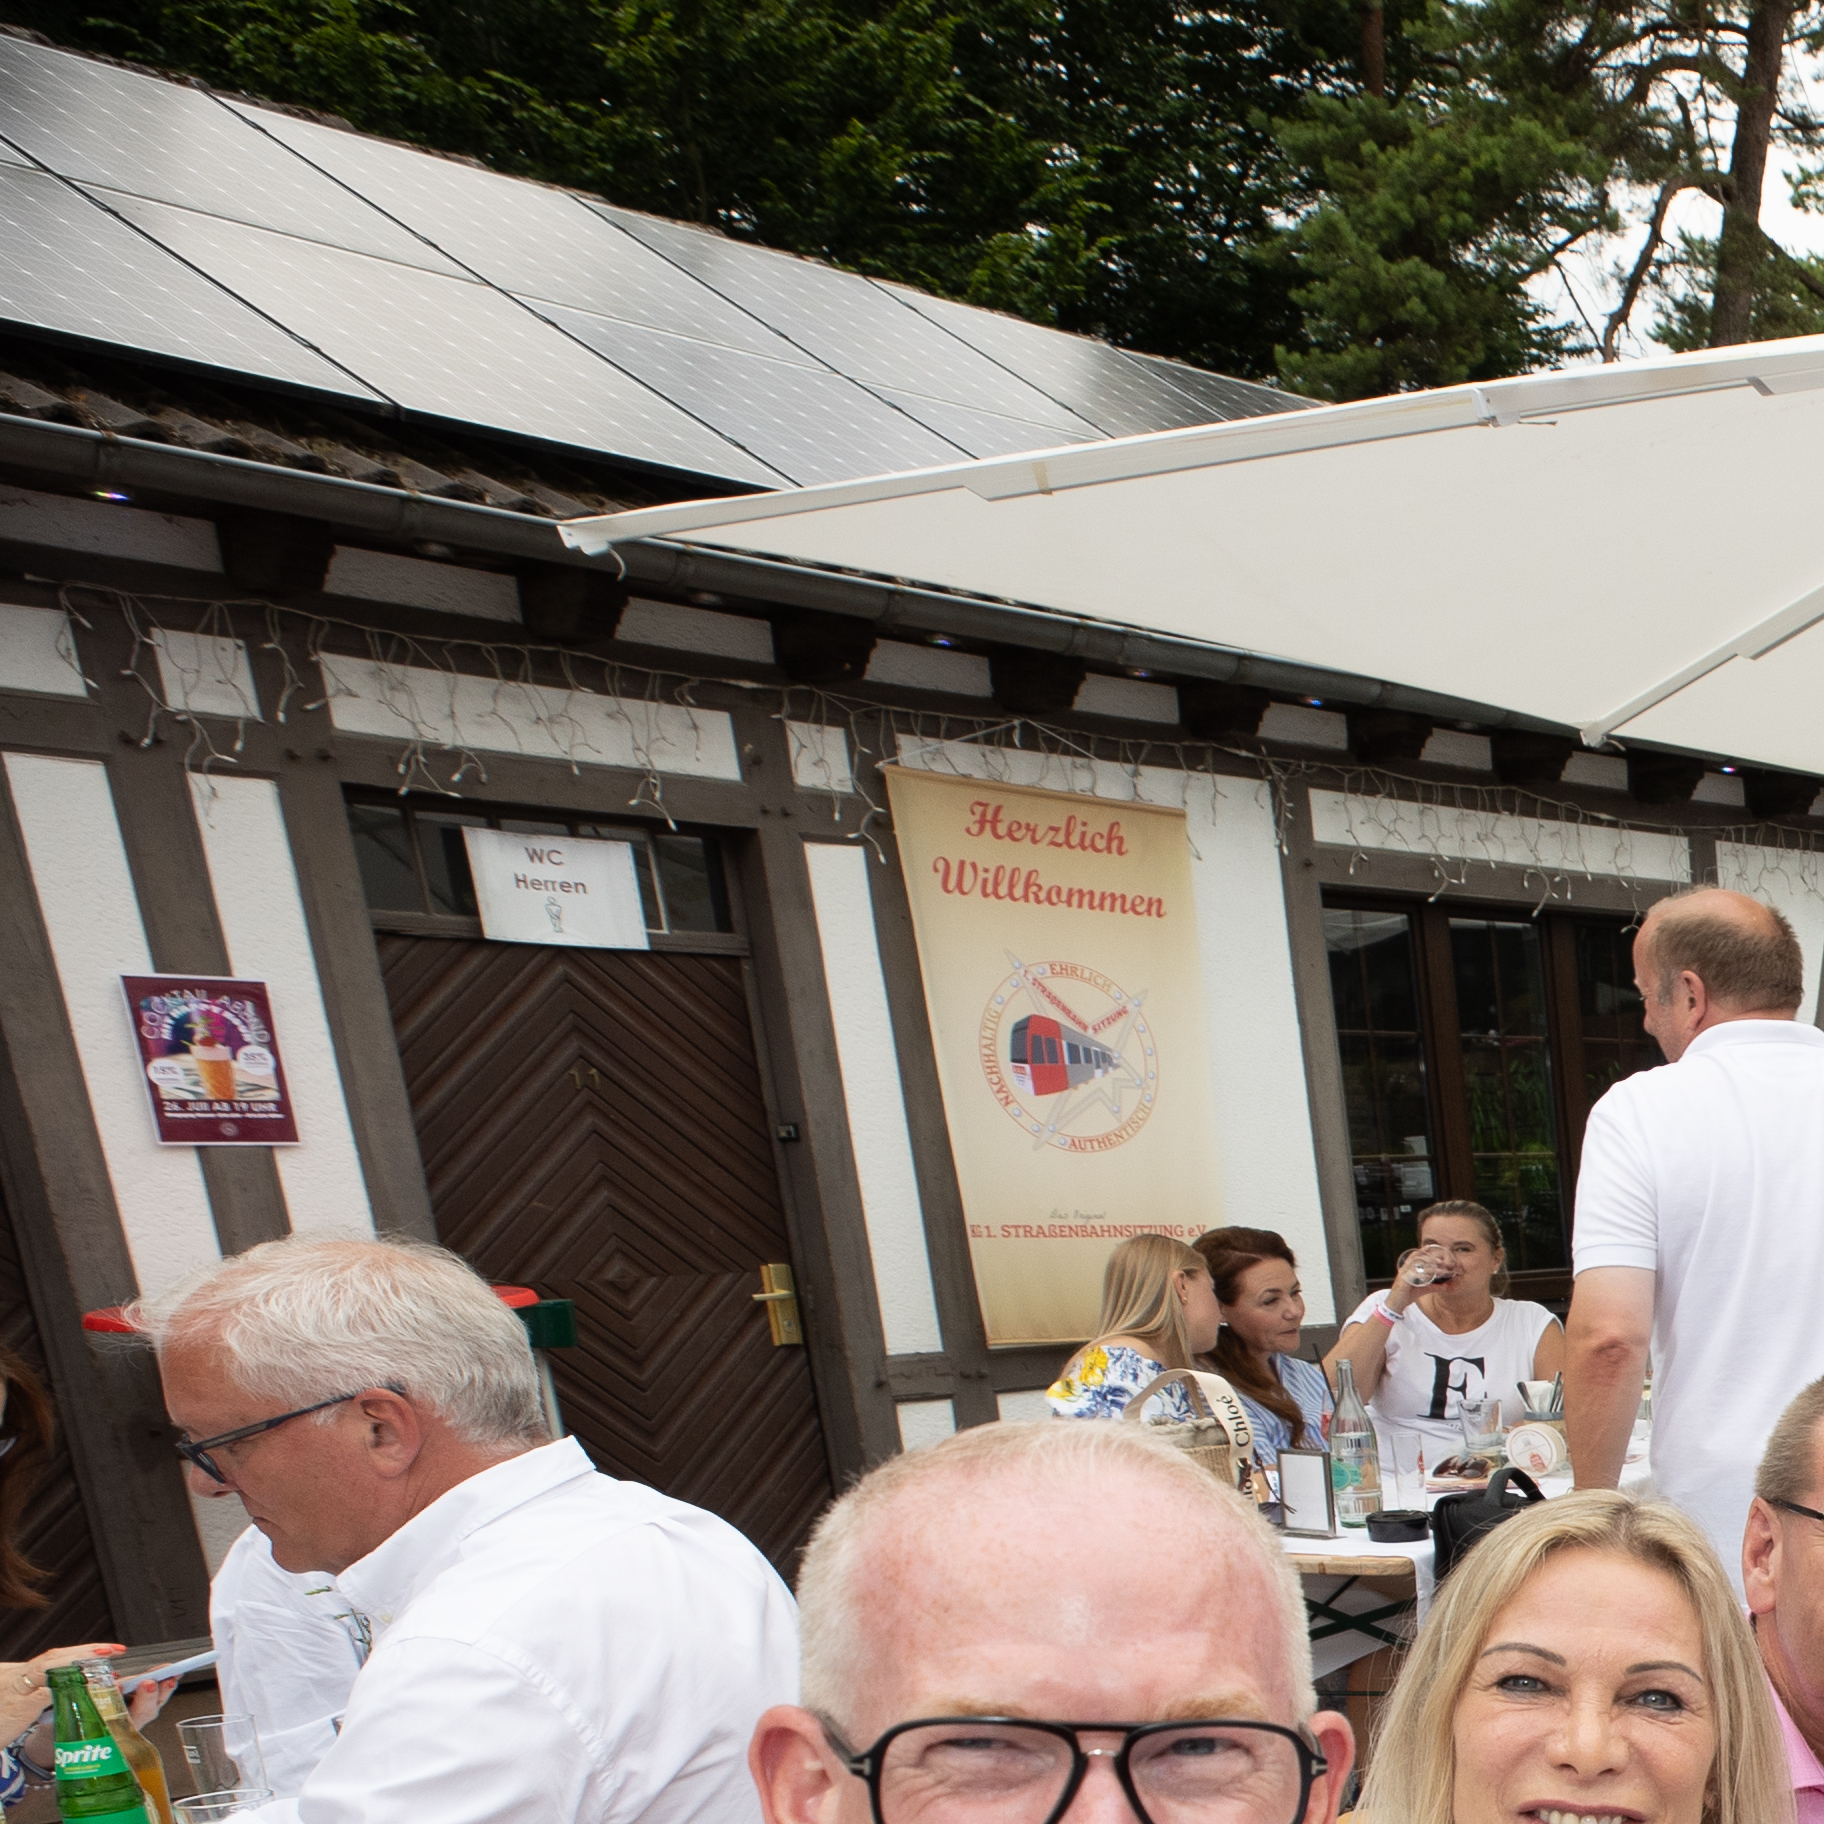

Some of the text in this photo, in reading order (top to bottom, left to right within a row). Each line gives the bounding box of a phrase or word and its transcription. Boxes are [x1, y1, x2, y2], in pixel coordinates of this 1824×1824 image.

[965, 800, 1129, 857] Herzlich
[523, 846, 565, 867] WC
[513, 872, 588, 895] Herren
[932, 856, 1167, 918] Willkommen
[1049, 963, 1114, 994] EHRLICH
[981, 1008, 1014, 1108] NACHHALTIG
[1067, 1102, 1151, 1152] AUTHENTISCH
[54, 1743, 113, 1768] Sprite
